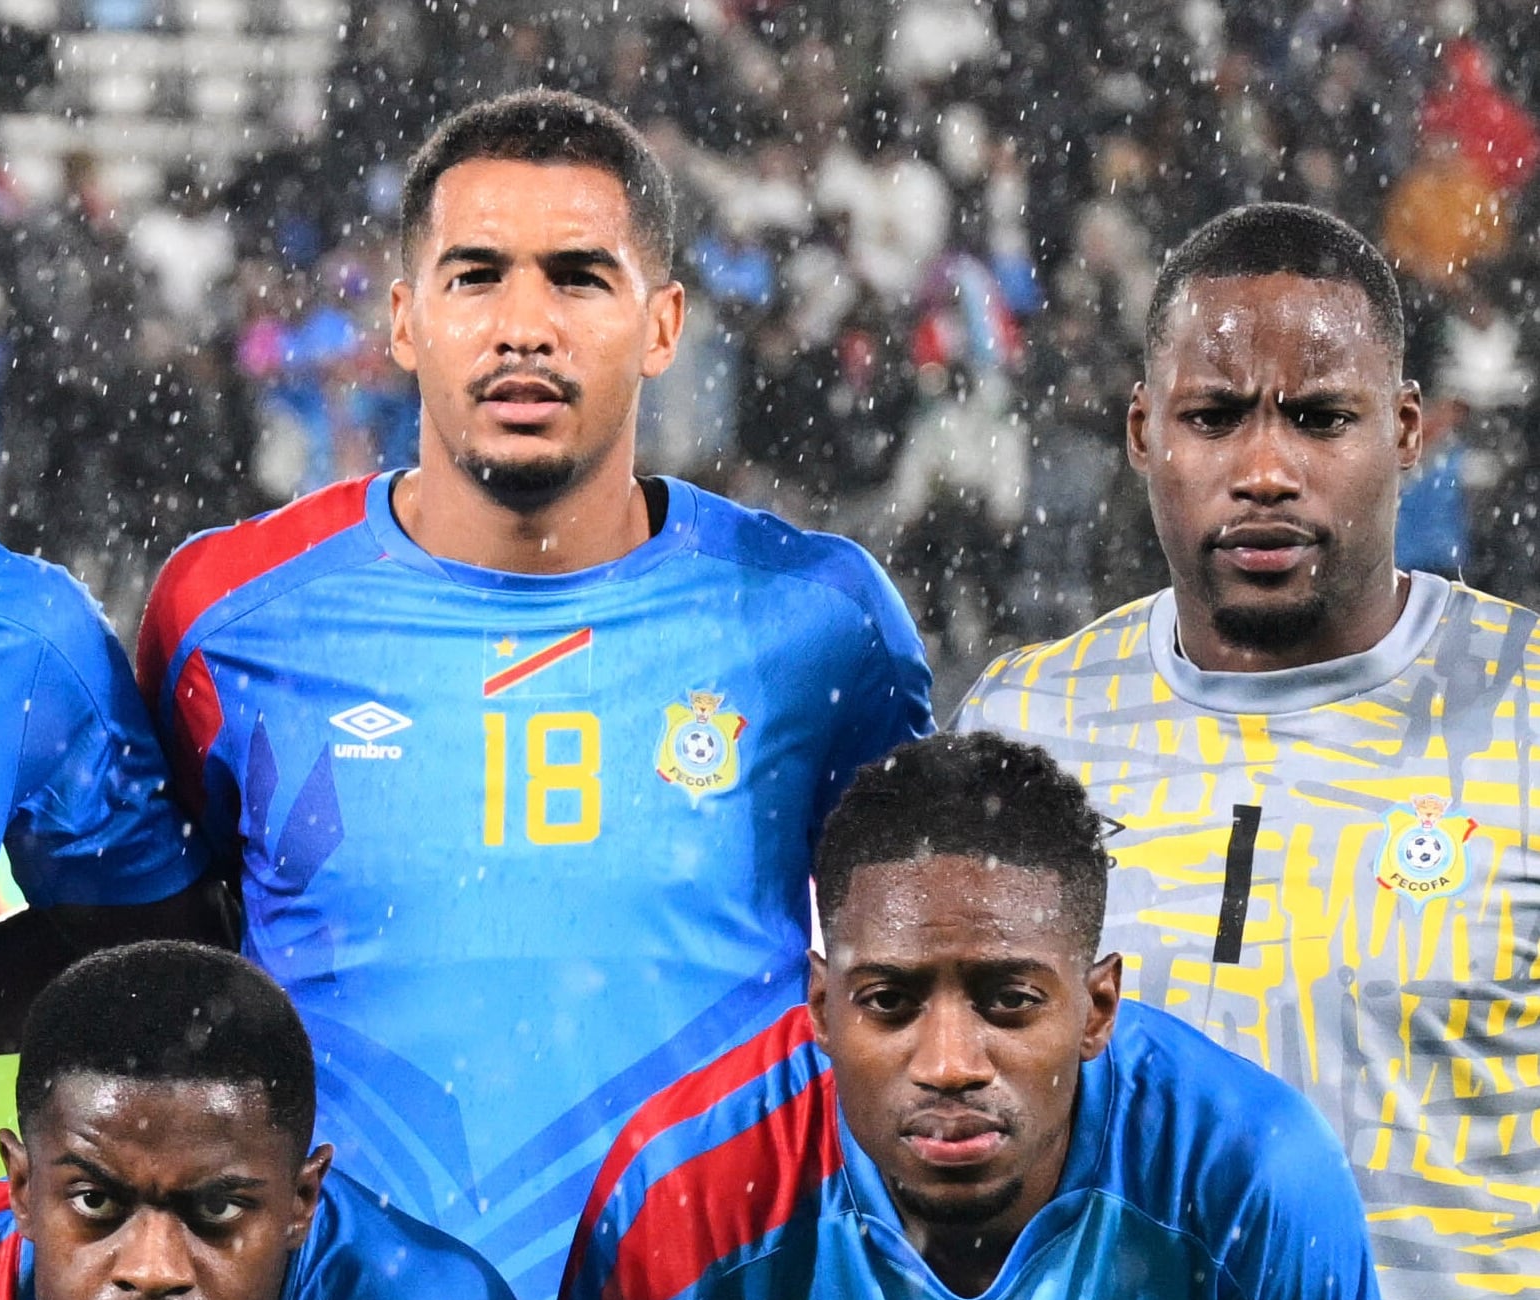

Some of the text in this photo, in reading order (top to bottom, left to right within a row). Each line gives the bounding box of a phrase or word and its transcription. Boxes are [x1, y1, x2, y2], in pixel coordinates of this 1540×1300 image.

[334, 741, 403, 759] umbro
[483, 711, 601, 846] 18
[669, 766, 723, 787] FECOFA
[1212, 804, 1262, 964] 1
[1390, 873, 1450, 891] FECOFA
